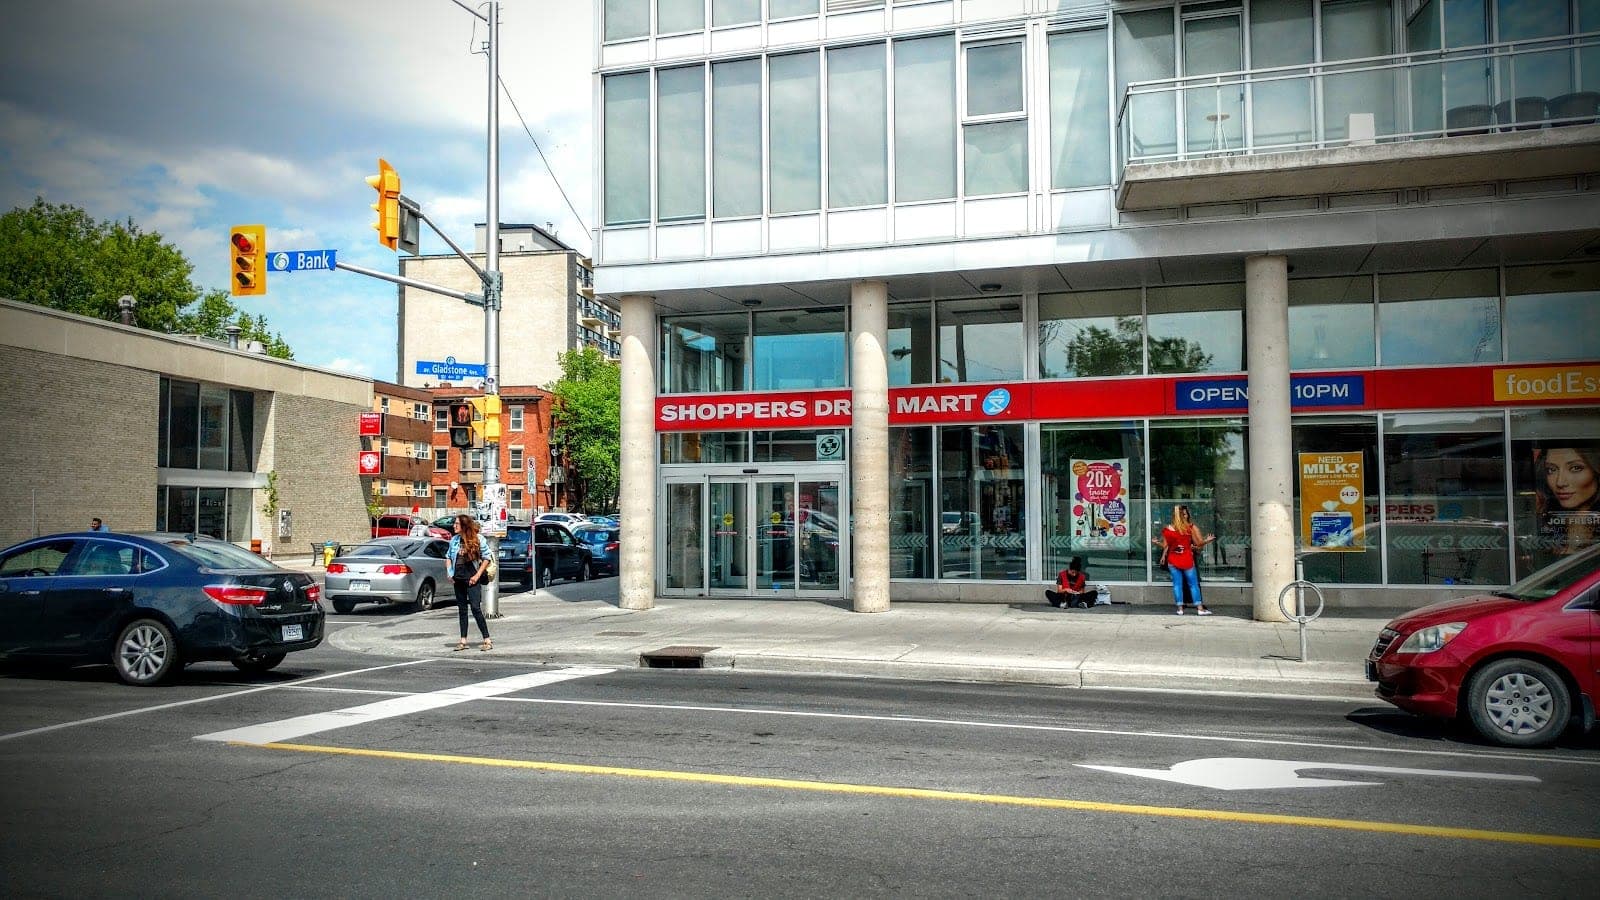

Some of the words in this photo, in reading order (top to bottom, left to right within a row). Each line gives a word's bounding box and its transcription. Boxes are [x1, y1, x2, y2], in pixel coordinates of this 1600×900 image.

[297, 250, 329, 269] Bank
[432, 364, 468, 375] Gladstone
[1505, 371, 1600, 395] foodEs
[1190, 386, 1249, 402] OPEN
[1295, 383, 1349, 399] 10PM
[660, 400, 807, 421] SHOPPERS
[814, 399, 851, 417] DR
[896, 394, 977, 414] MART
[1318, 456, 1344, 464] NEED
[1303, 463, 1360, 474] MILK?
[1086, 470, 1113, 488] 20x
[1365, 504, 1435, 514] OPPERS
[1547, 517, 1566, 526] JOE
